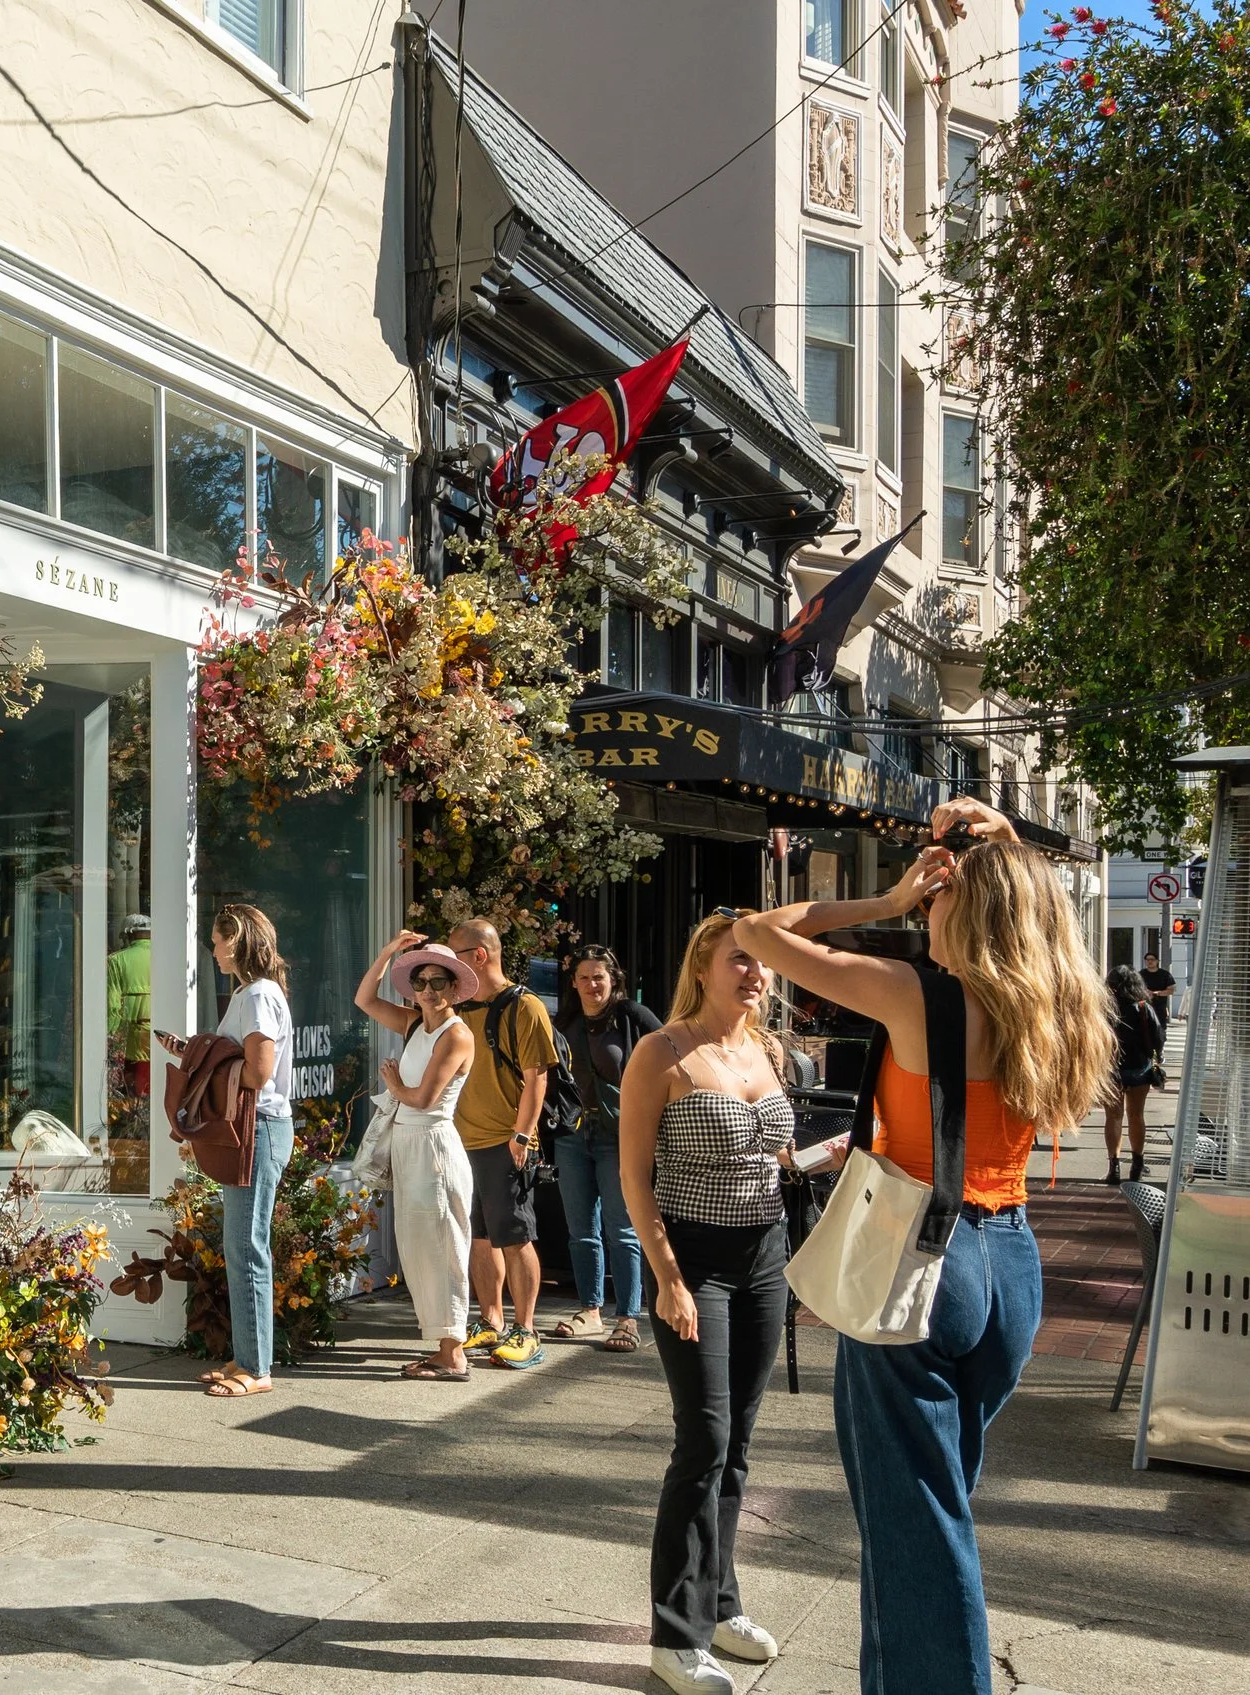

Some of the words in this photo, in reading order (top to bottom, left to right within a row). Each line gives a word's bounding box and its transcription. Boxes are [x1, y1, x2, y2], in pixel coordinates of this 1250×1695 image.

[35, 555, 119, 603] SÉZANE
[579, 710, 720, 756] RRY'S
[572, 747, 660, 767] BAR
[296, 1024, 331, 1059] LOVES
[290, 1063, 334, 1100] NCISCO
